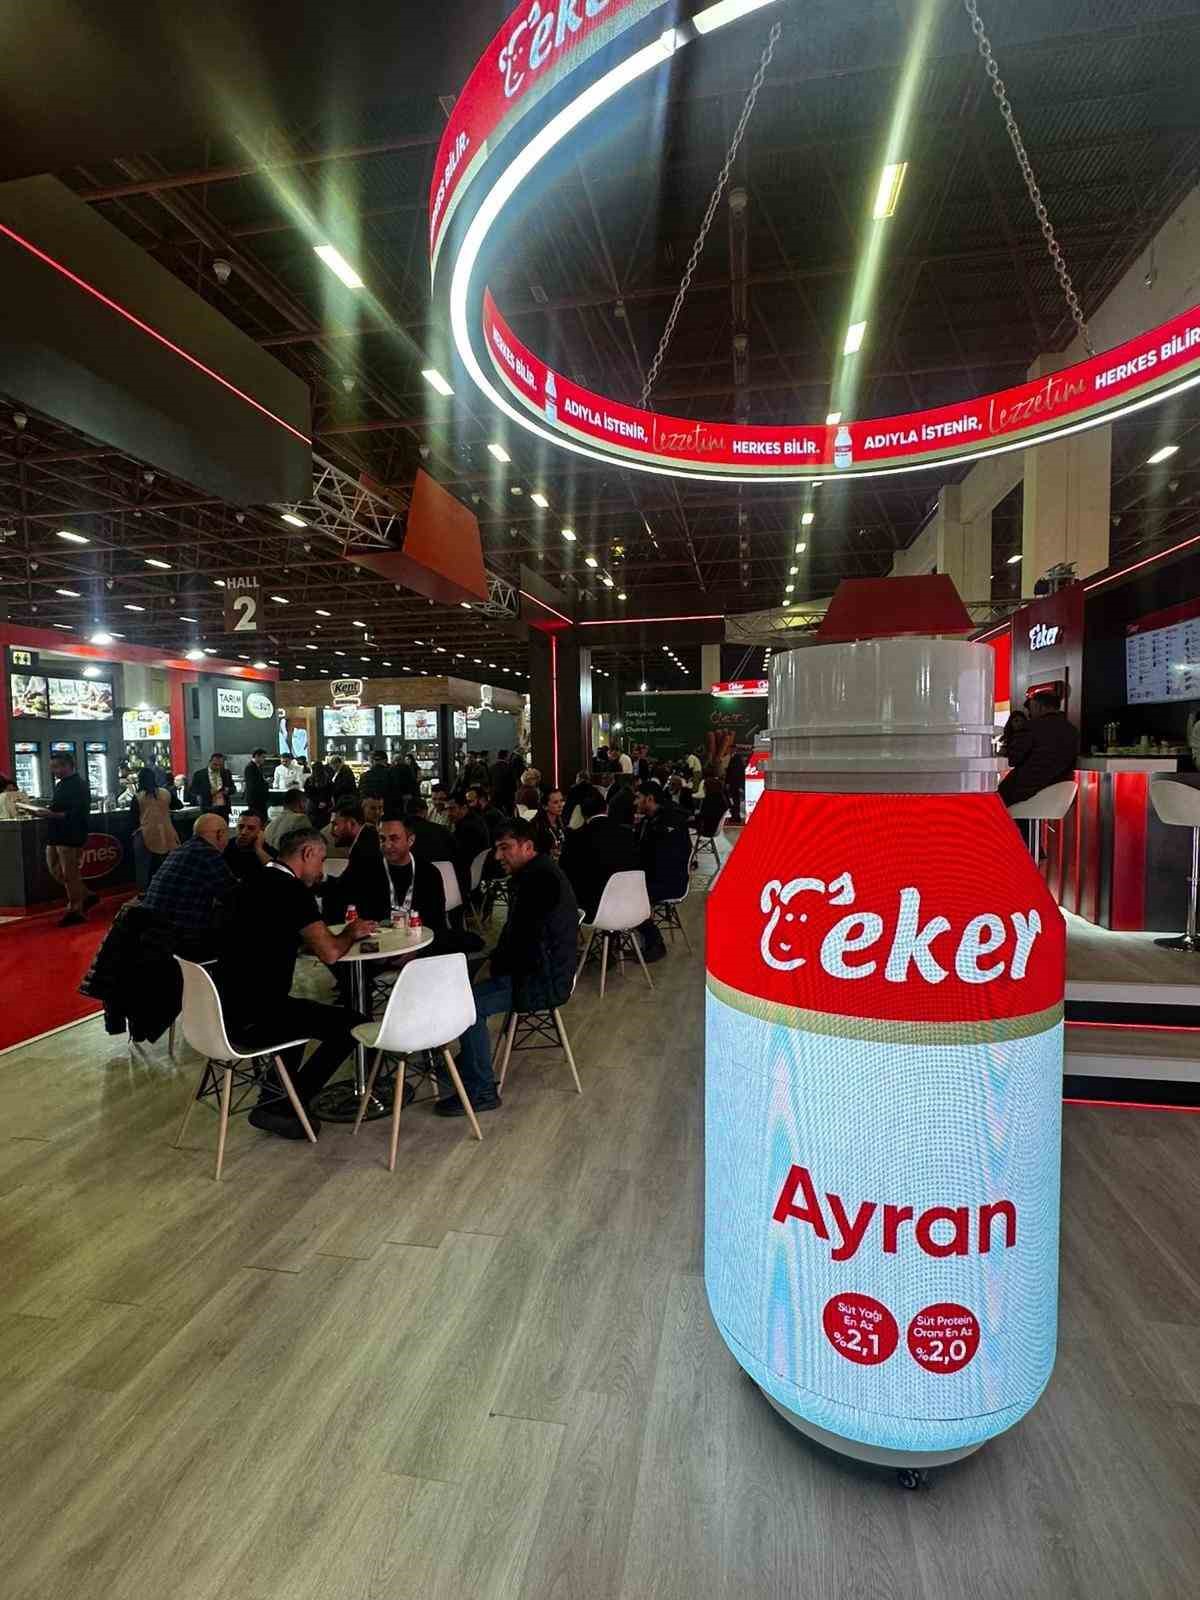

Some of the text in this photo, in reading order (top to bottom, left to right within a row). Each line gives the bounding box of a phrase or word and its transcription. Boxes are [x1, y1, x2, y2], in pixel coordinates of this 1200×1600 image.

[863, 430, 919, 450] ADIYLA
[921, 416, 983, 441] İSTENİR,
[1094, 349, 1158, 391] HERKES
[564, 397, 602, 428] ADIYLA
[603, 412, 649, 444] İSTENİR,
[732, 439, 781, 455] HERKES
[784, 437, 820, 455] BİLİR.
[226, 575, 261, 590] HALL
[233, 595, 257, 631] 2
[772, 1163, 1017, 1262] Ayran
[837, 1302, 857, 1316] Süt
[916, 1314, 973, 1326] Süt Protein
[843, 1315, 875, 1332] En Az
[945, 1327, 959, 1337] En
[960, 1326, 973, 1337] Az
[833, 1328, 880, 1356] %2,1
[915, 1339, 967, 1366] %2,0
